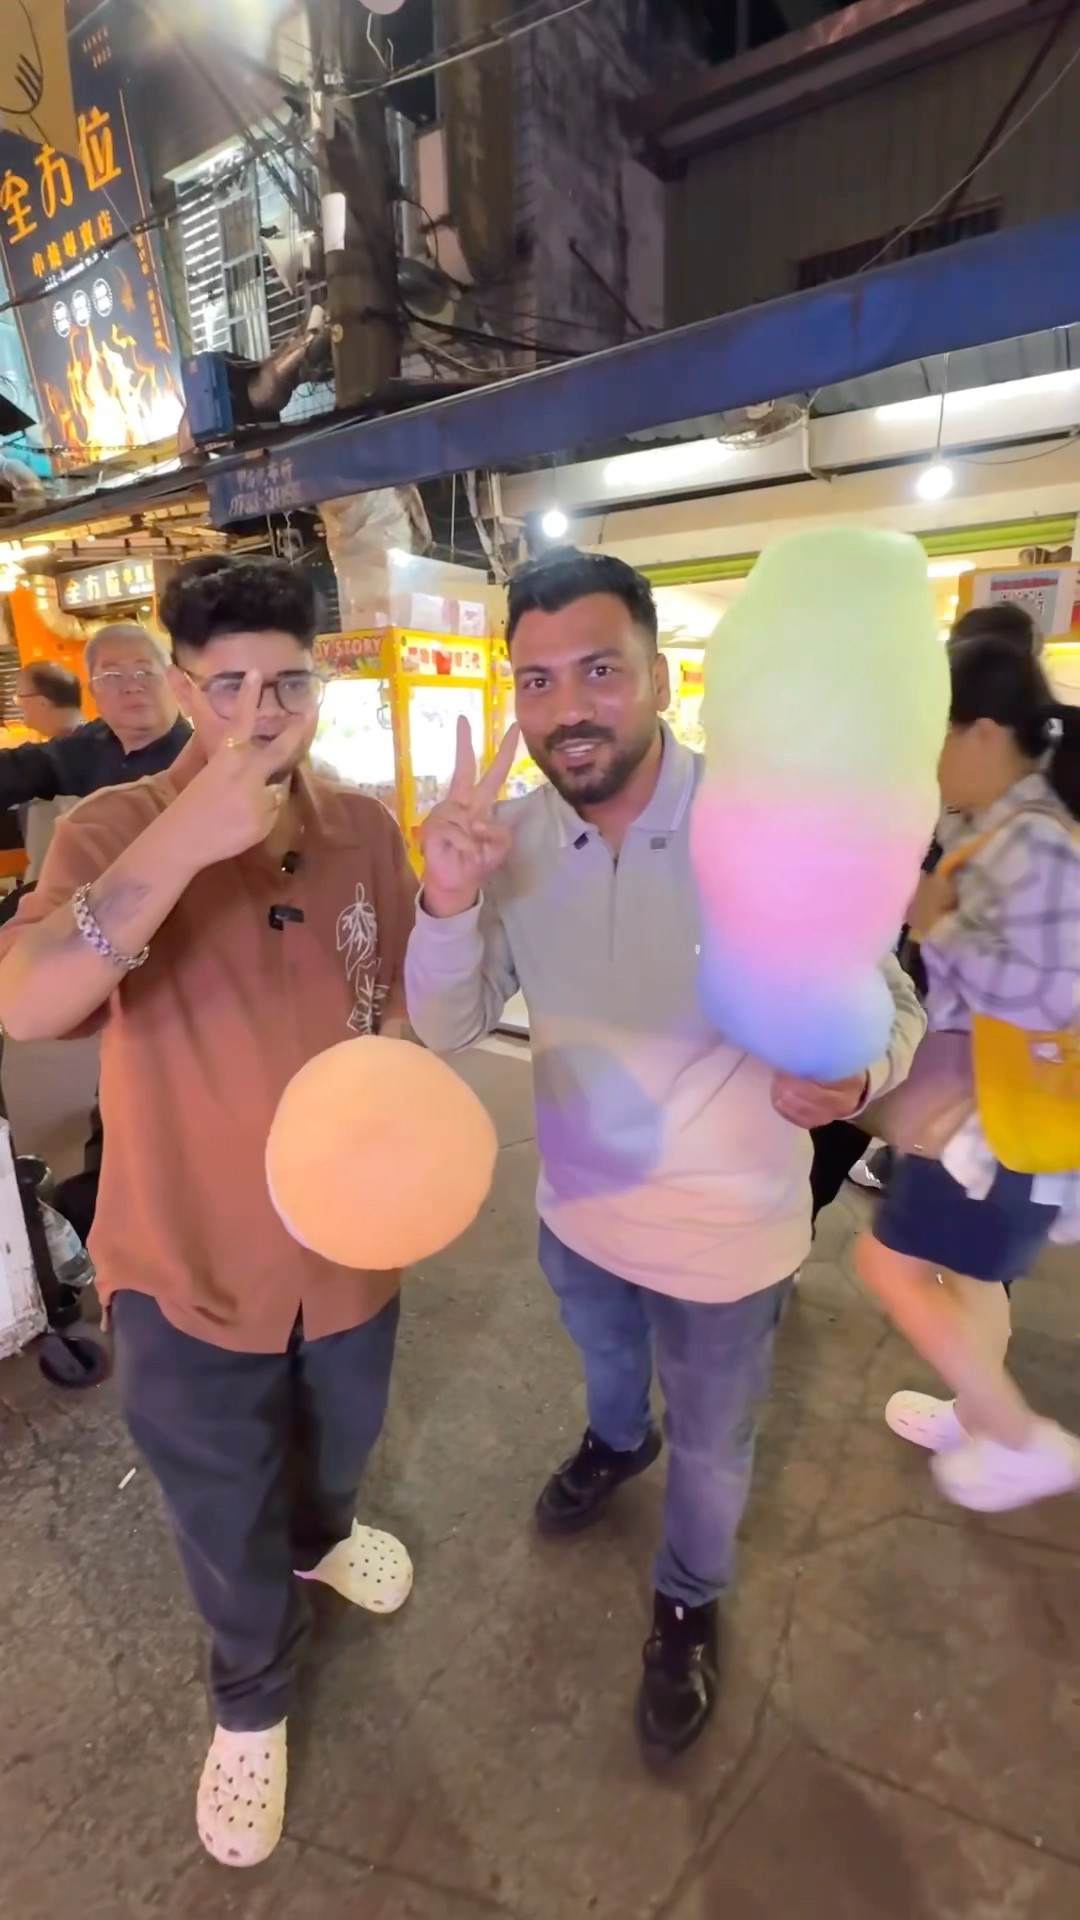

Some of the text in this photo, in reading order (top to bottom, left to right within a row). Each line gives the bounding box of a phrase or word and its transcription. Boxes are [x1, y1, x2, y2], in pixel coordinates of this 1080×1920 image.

[0, 105, 122, 245] 全方位
[311, 637, 382, 662] OY STORY
